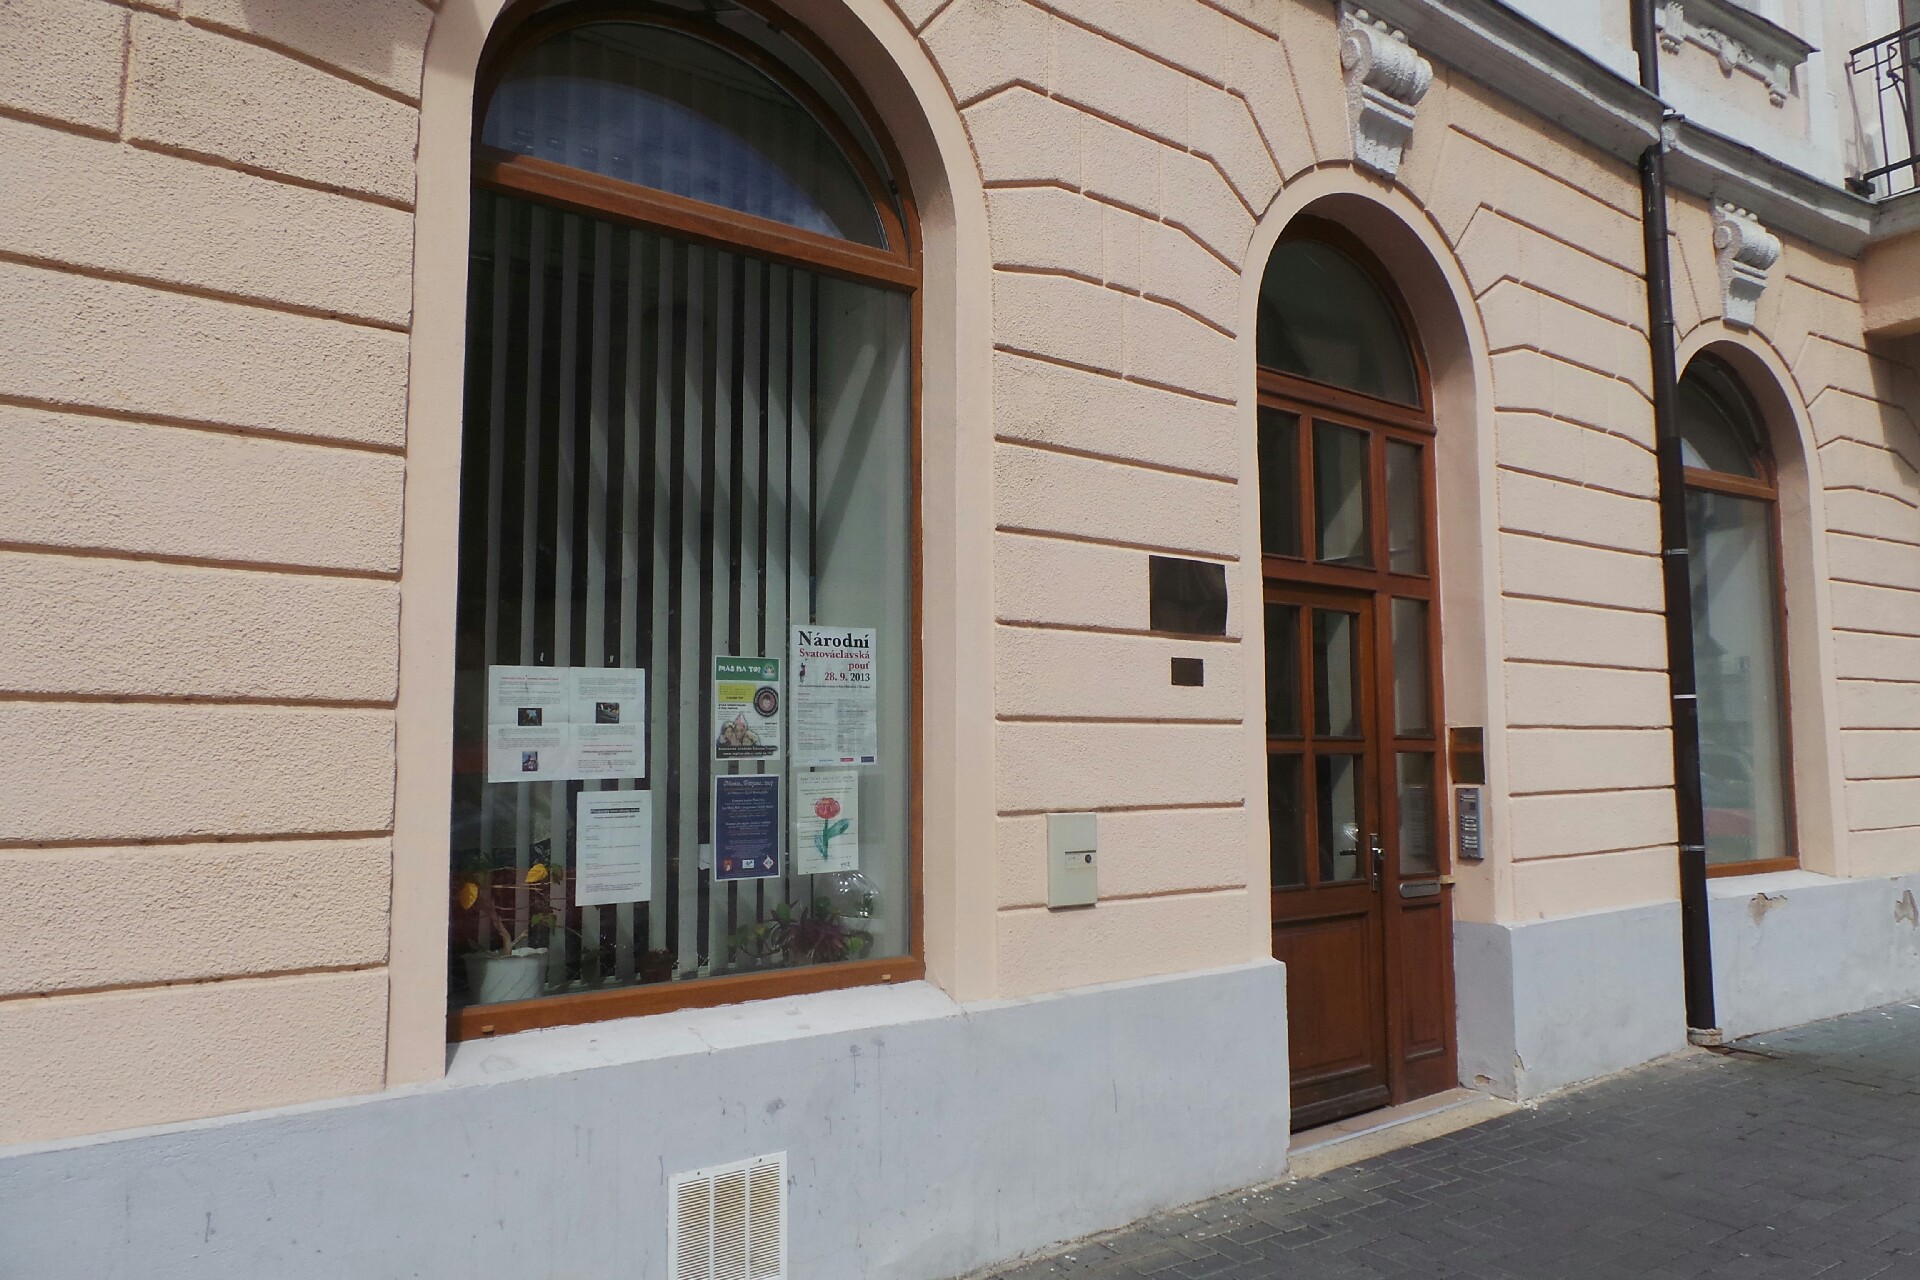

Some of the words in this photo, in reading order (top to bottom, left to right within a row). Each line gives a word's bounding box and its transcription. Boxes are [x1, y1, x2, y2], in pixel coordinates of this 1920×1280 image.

[798, 630, 870, 648] Národní
[799, 648, 870, 660] Svatováclavská
[848, 661, 870, 671] pouť
[824, 671, 837, 681] 28.
[840, 672, 848, 682] 9.
[850, 672, 870, 682] 2013
